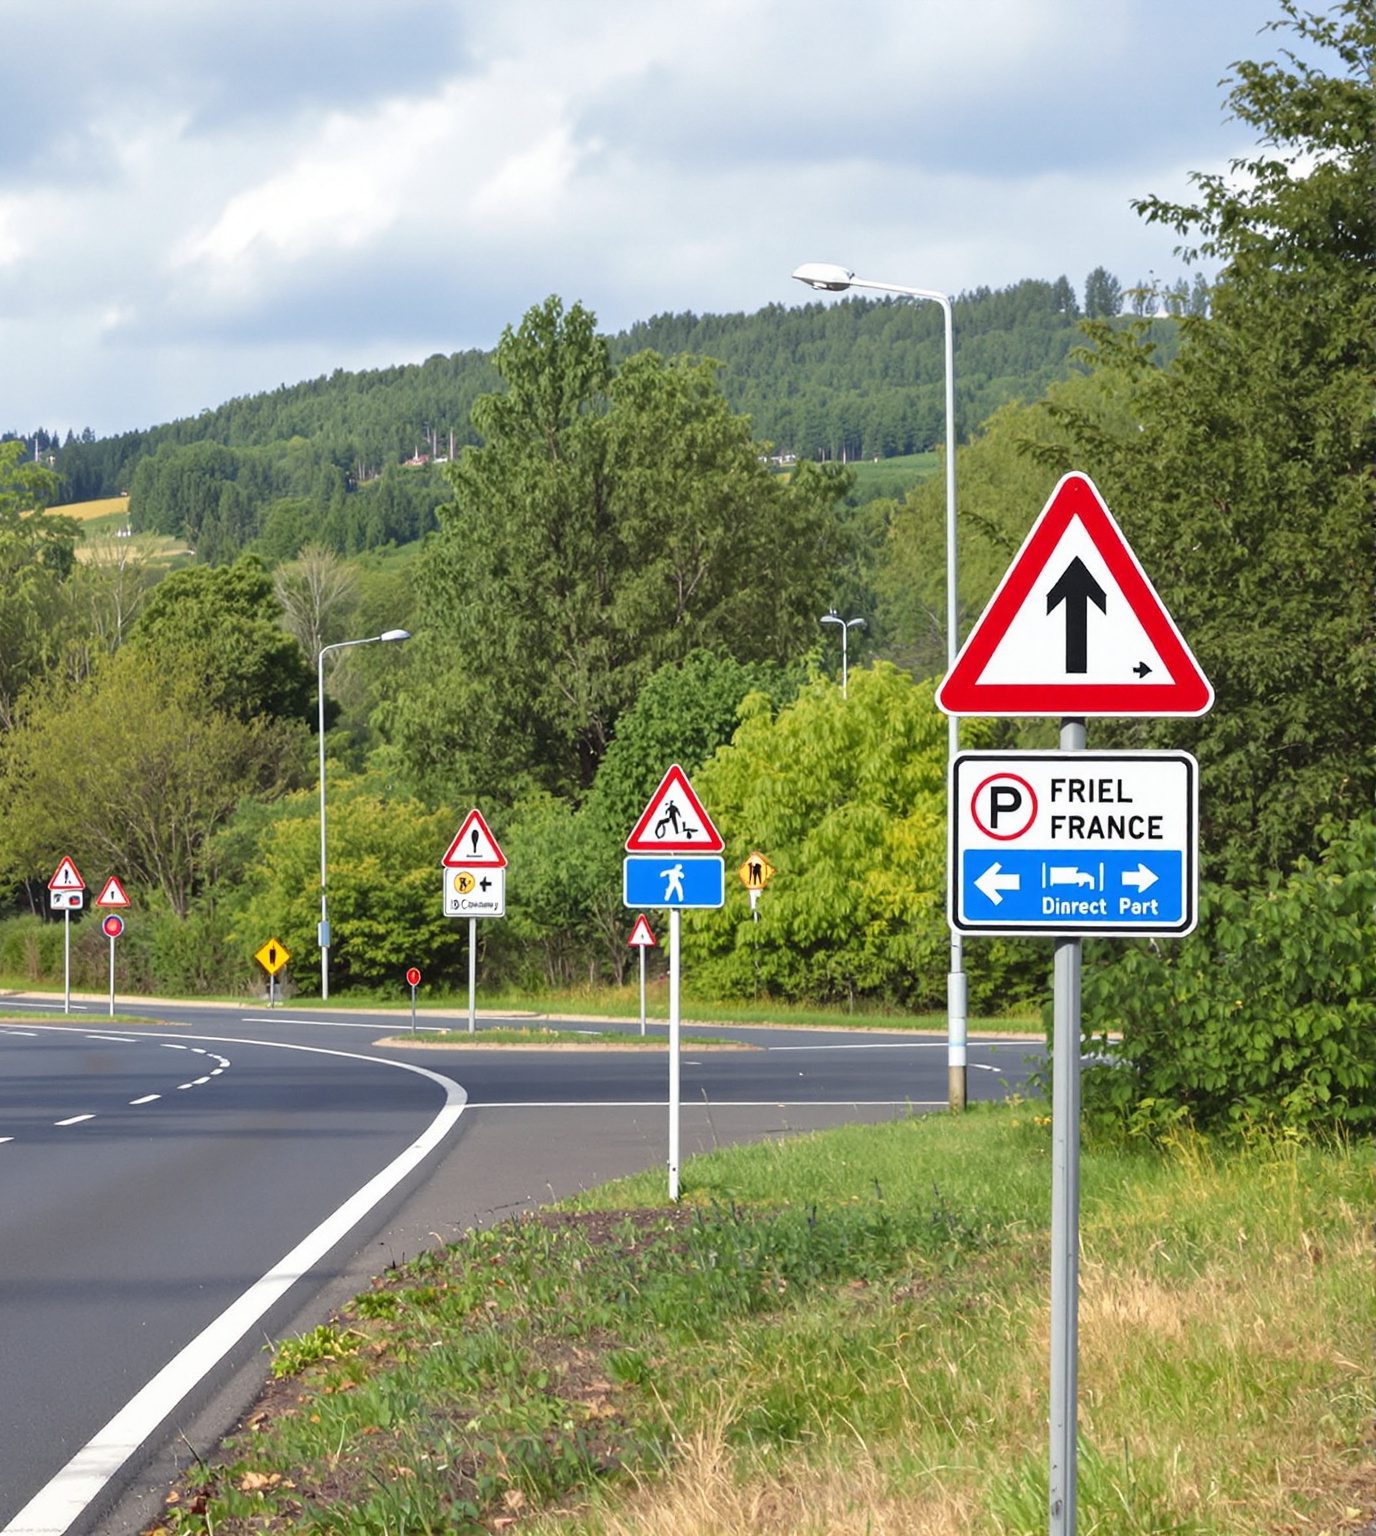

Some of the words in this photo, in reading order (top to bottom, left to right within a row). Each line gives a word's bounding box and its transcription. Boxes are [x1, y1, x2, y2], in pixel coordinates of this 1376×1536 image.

[1050, 778, 1133, 803] FRIEL
[990, 785, 1022, 829] P
[1050, 815, 1164, 840] FRANCE
[1042, 896, 1107, 915] Dinrect
[1119, 897, 1159, 915] Part
